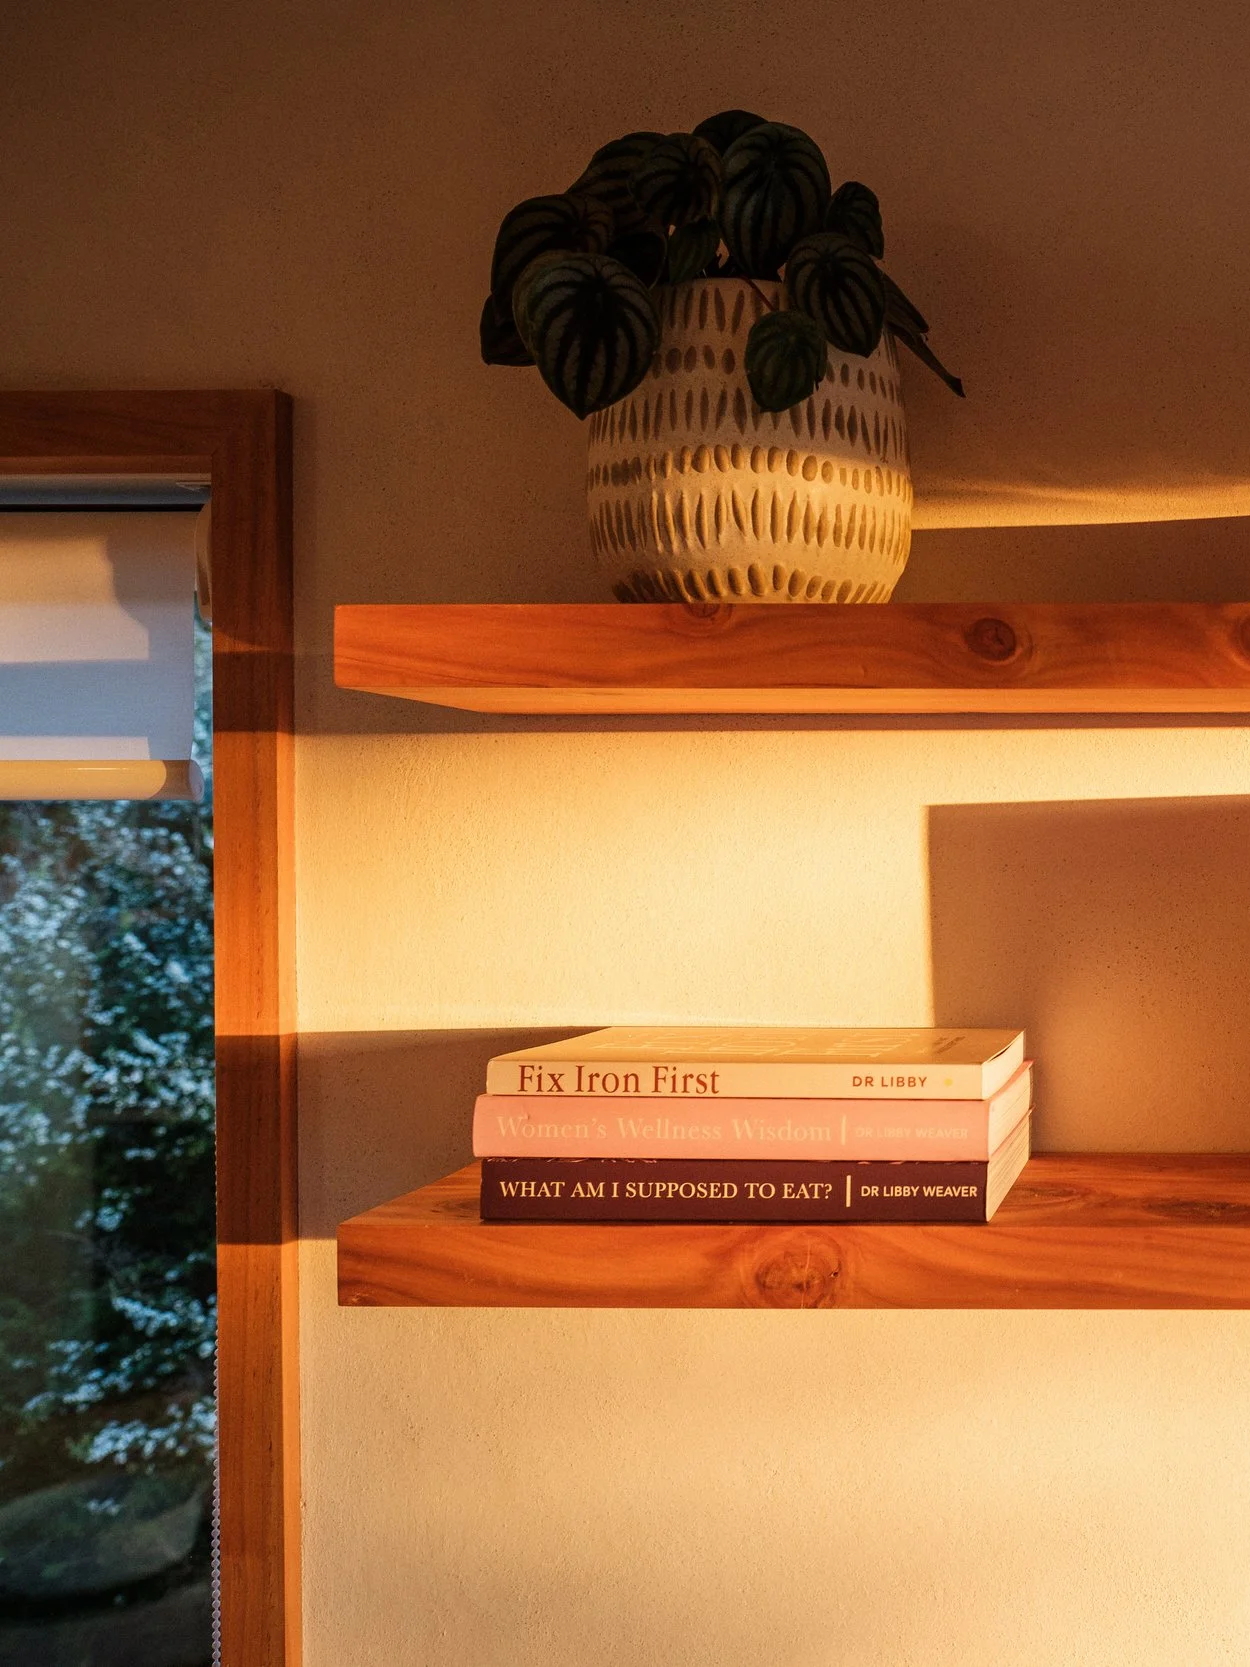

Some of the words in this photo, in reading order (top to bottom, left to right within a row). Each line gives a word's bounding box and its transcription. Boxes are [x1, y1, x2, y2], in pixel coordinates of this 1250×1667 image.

[517, 1065, 565, 1093] Fix
[575, 1065, 640, 1094] Iron
[651, 1066, 720, 1095] First
[852, 1076, 874, 1087] DR
[881, 1076, 928, 1088] LIBBY
[497, 1115, 607, 1138] Women’s
[616, 1118, 722, 1140] Wellness
[732, 1119, 832, 1142] Wisdom
[855, 1127, 873, 1138] DR
[877, 1127, 911, 1139] LIBBY
[915, 1128, 968, 1139] WEAVER
[500, 1181, 565, 1197] WHAT
[570, 1182, 604, 1198] AM
[611, 1182, 618, 1198] I
[625, 1182, 738, 1199] SUPPOSED
[744, 1183, 776, 1199] TO
[782, 1183, 833, 1200] EAT?
[861, 1186, 879, 1197] DR
[882, 1186, 919, 1198] LIBBY
[922, 1186, 977, 1198] WEAVER
